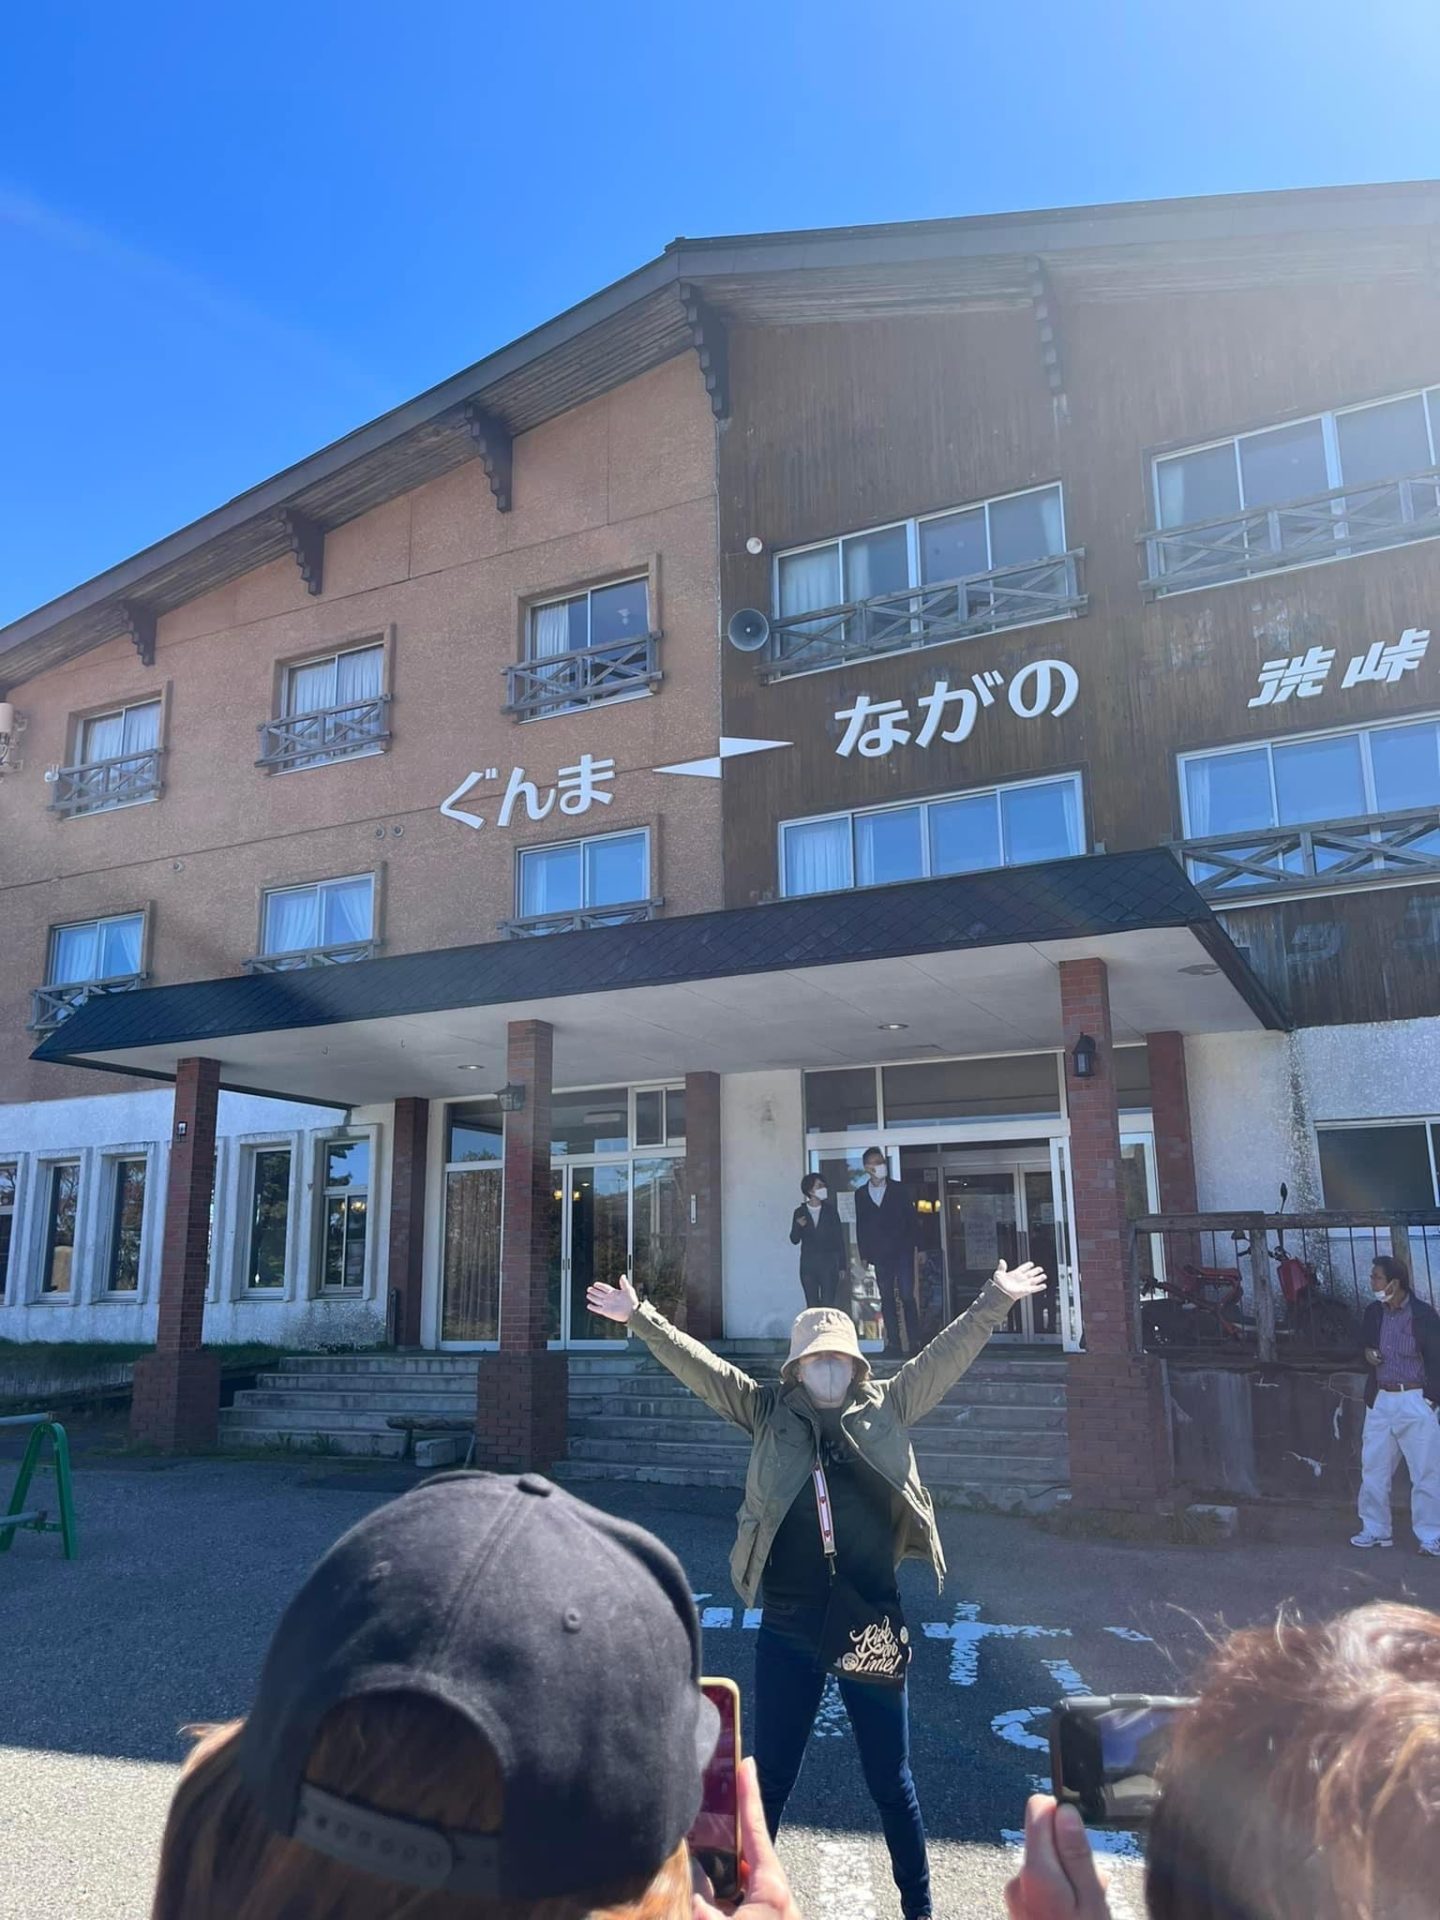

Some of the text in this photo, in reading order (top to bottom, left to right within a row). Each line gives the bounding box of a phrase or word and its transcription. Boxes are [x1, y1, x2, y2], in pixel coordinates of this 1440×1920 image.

[1247, 628, 1431, 708] 渋峠
[834, 660, 1080, 758] ながの
[440, 753, 616, 830] ぐんま
